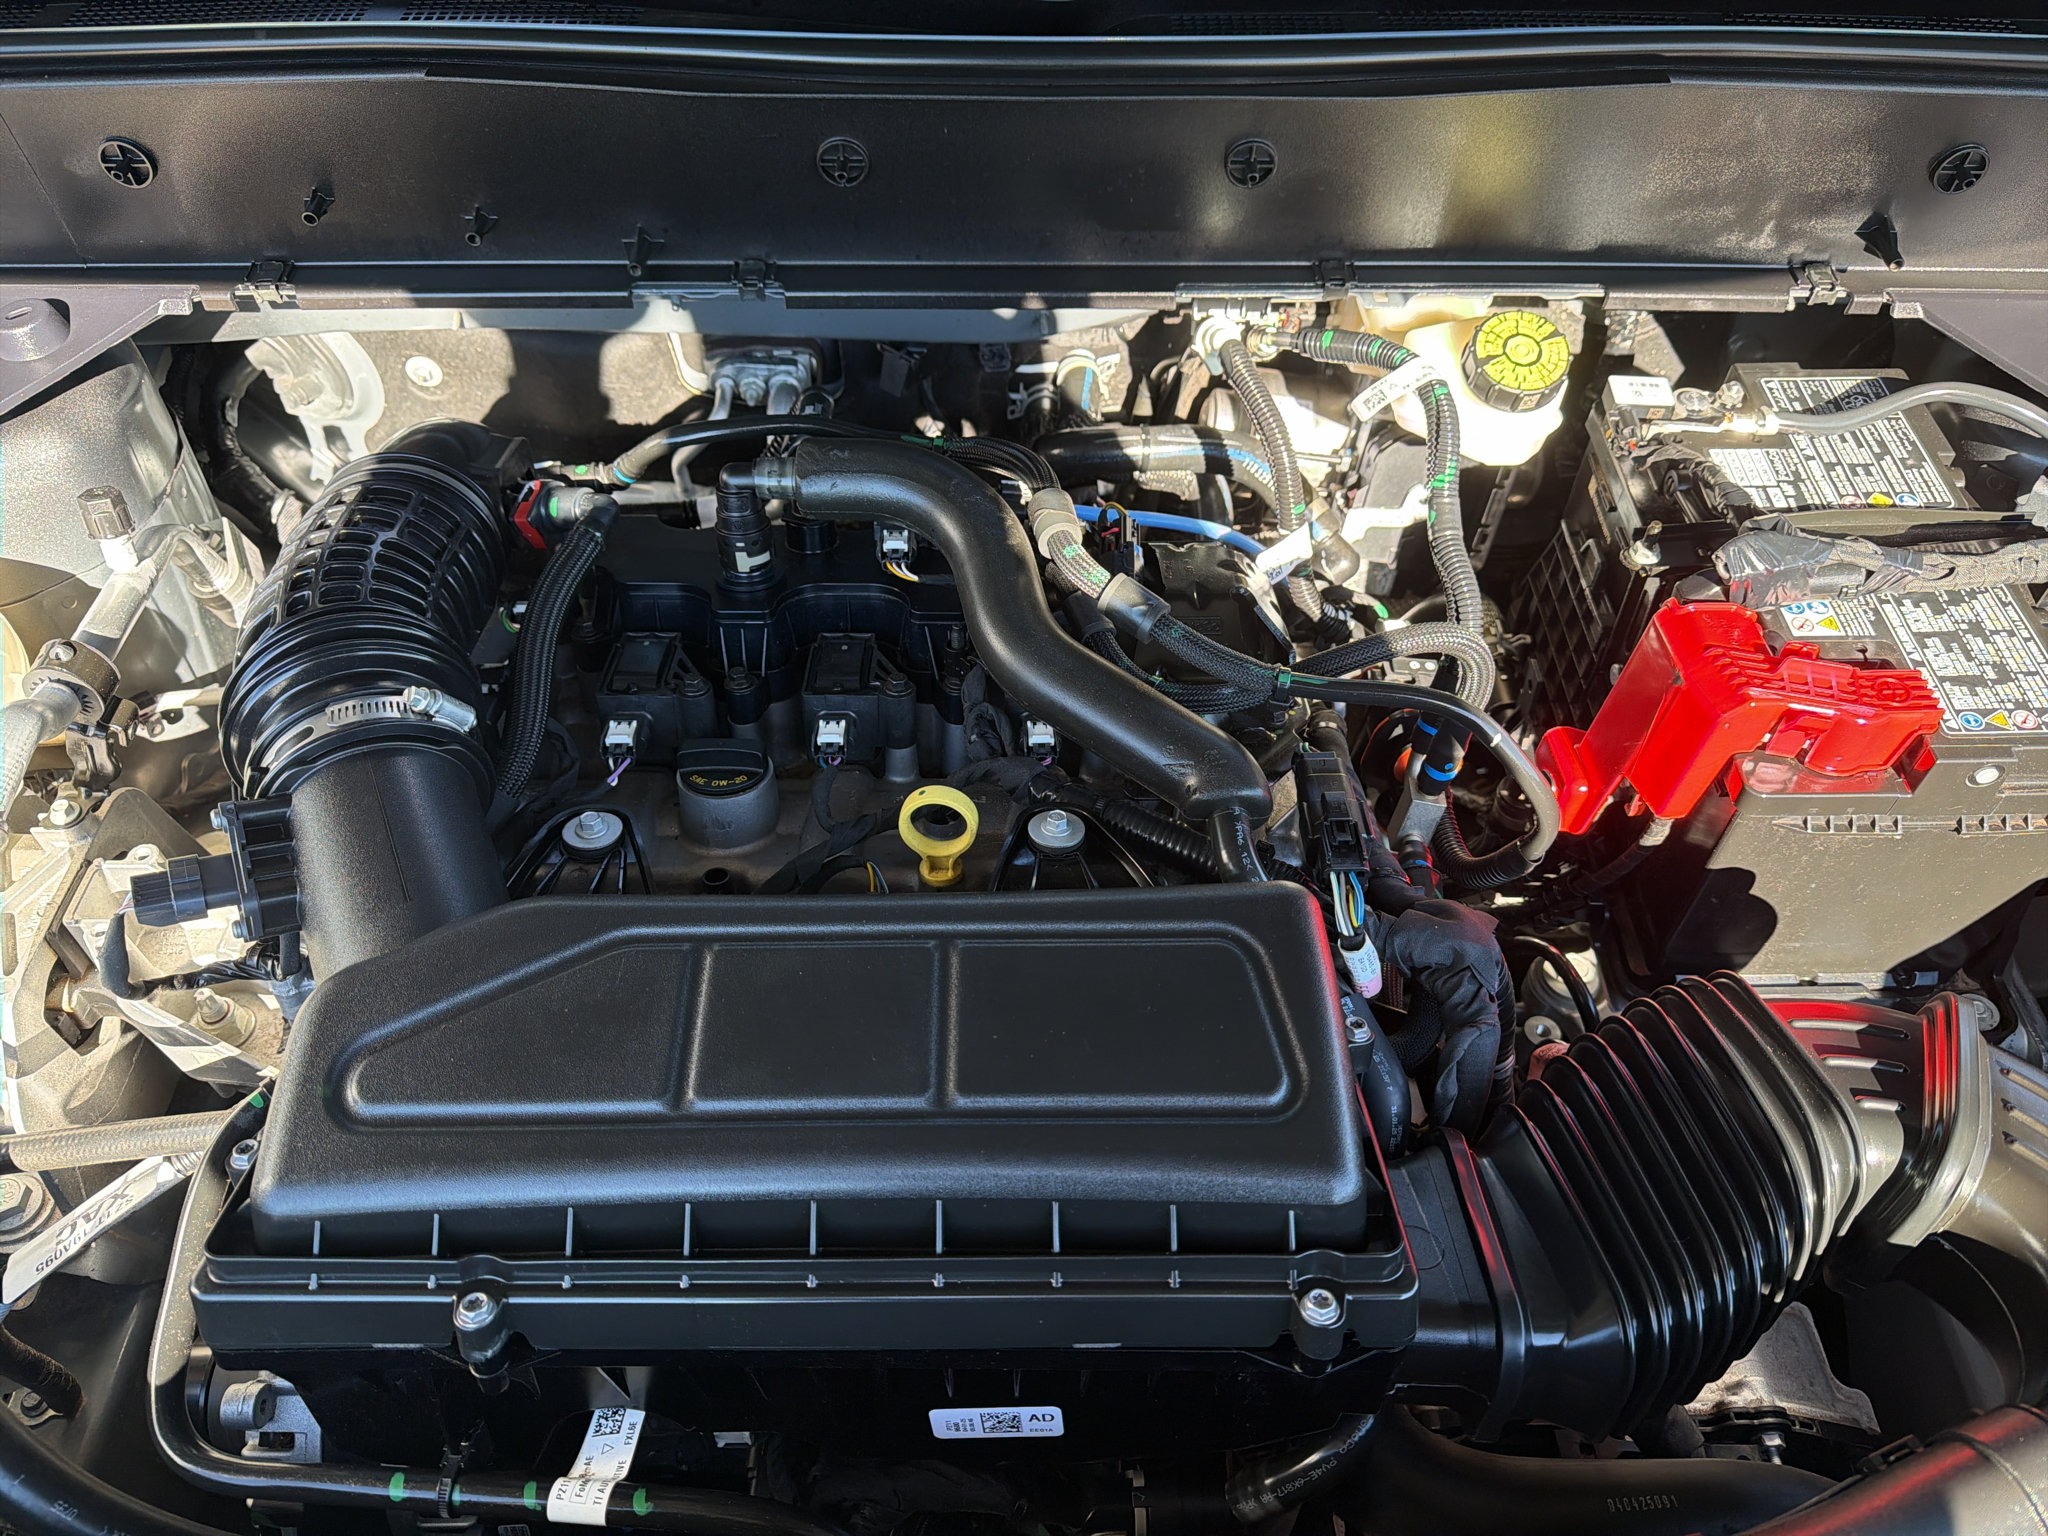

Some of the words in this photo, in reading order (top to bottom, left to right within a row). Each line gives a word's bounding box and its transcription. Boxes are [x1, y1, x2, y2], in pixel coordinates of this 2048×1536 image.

[689, 775, 708, 785] SAE
[711, 775, 748, 786] 0W-20
[50, 1181, 136, 1247] XAC
[31, 1228, 92, 1275] 19A095
[1029, 1414, 1055, 1422] AD
[593, 1496, 602, 1505] TI
